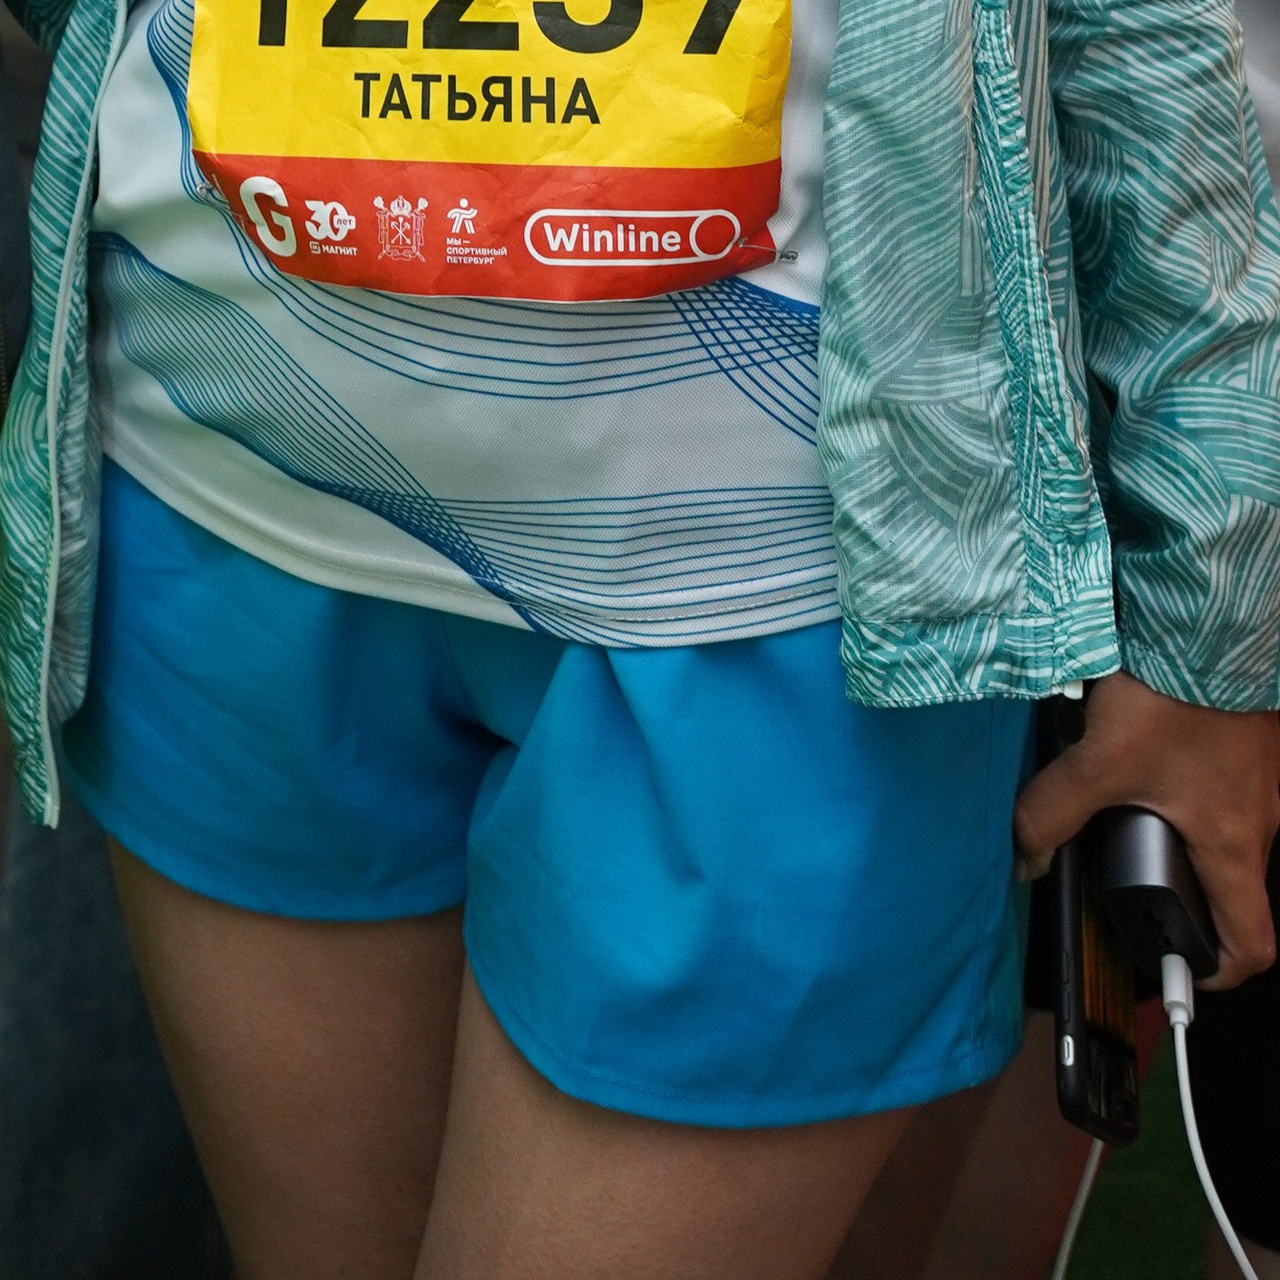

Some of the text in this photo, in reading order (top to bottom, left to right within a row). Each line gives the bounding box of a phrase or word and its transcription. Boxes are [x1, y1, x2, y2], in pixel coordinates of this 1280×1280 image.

[353, 72, 602, 126] ТАТЬЯНА
[239, 175, 298, 257] G
[304, 199, 350, 242] 30
[321, 243, 358, 257] МАГНИТ
[446, 246, 508, 256] СПОРТИВНЫЙ
[543, 222, 682, 253] Winline
[446, 255, 495, 265] ПЕТЕРБУРГ
